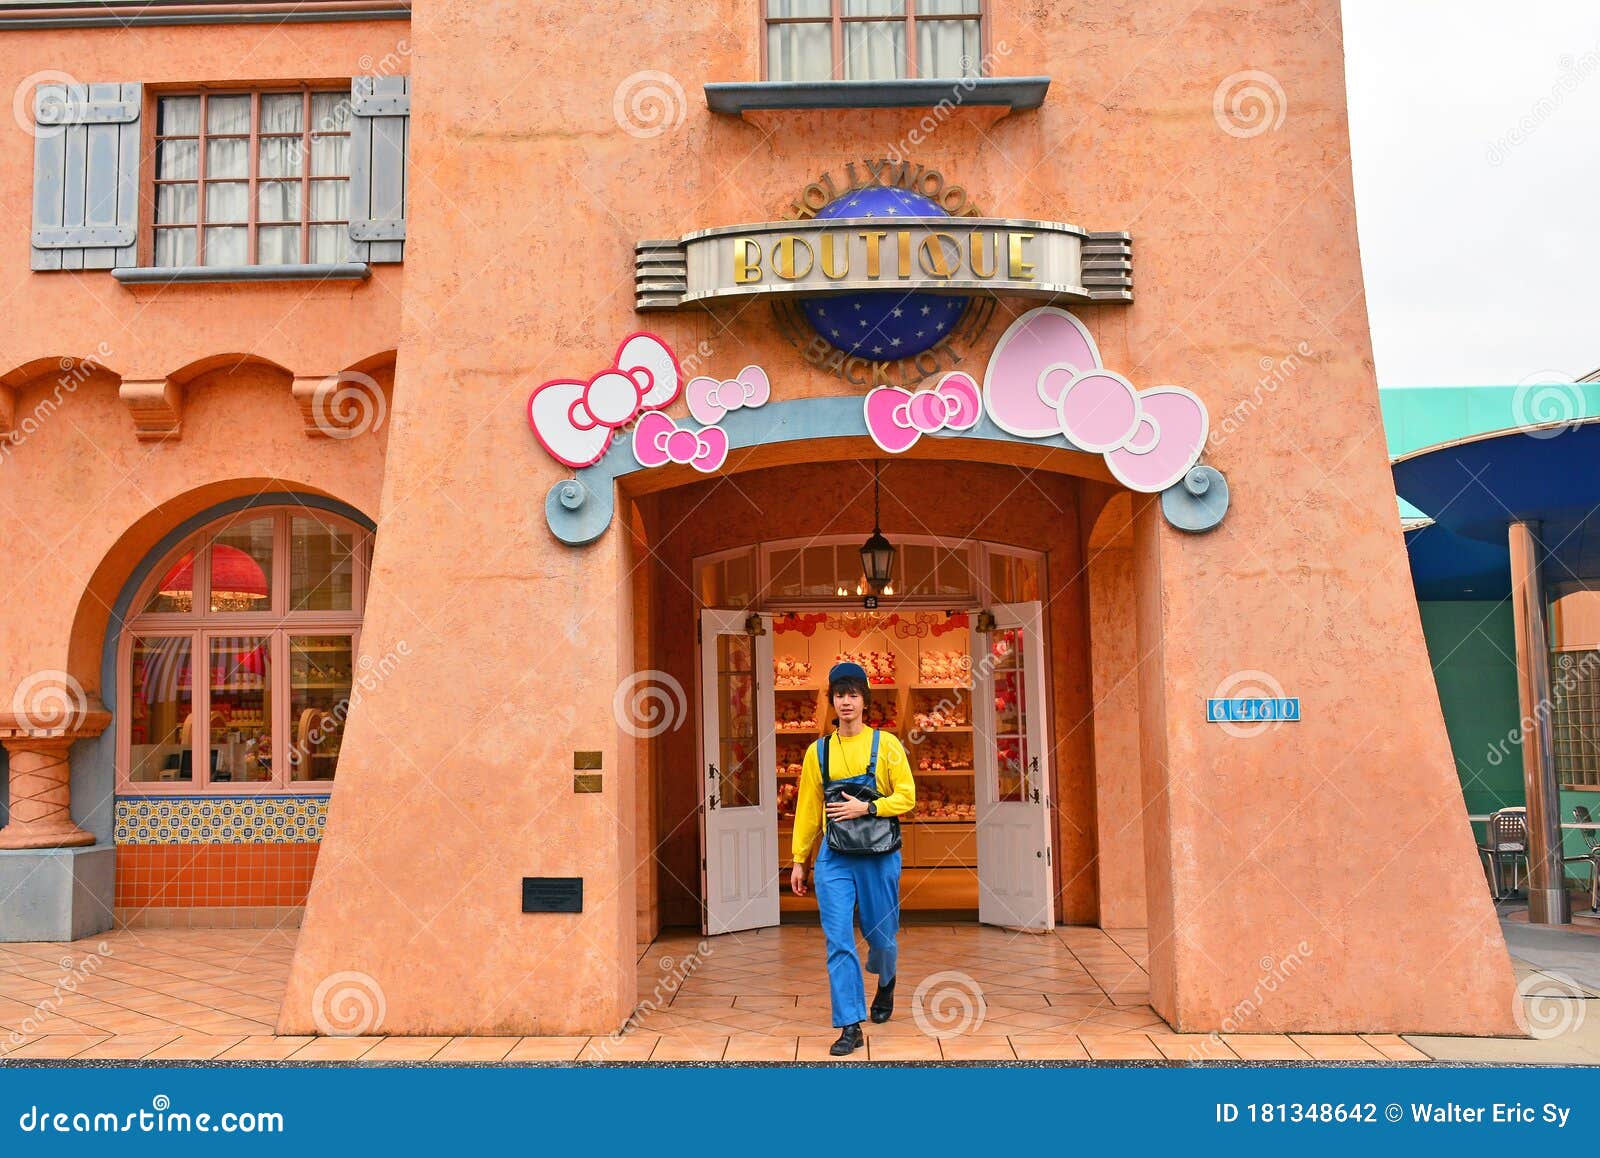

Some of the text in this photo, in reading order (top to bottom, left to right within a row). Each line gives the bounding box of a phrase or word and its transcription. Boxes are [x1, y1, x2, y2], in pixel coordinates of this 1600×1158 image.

[733, 231, 1036, 284] BOUTIQUE
[801, 334, 963, 387] BACKLOT
[1213, 700, 1295, 719] 6460
